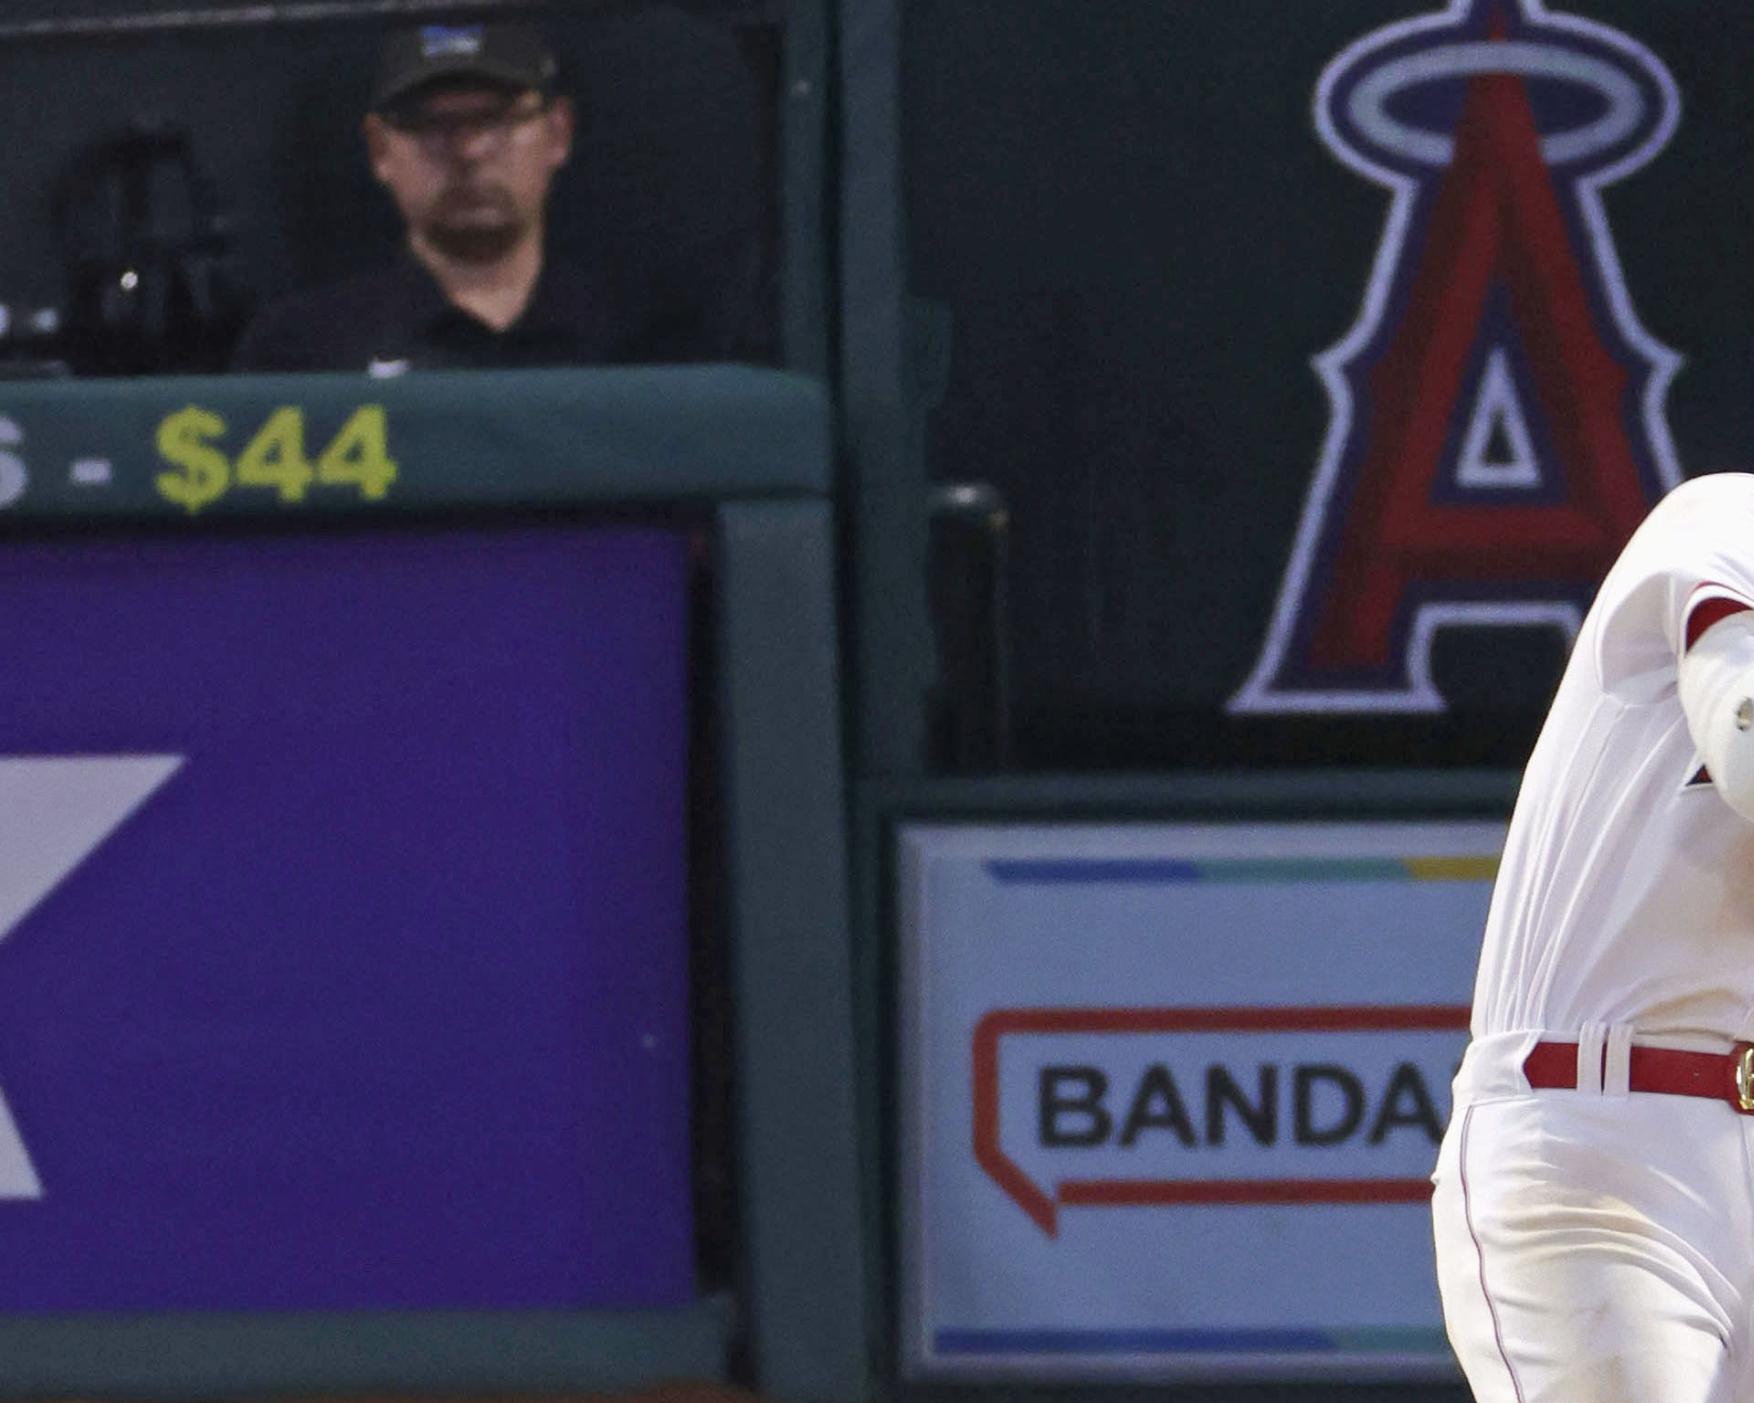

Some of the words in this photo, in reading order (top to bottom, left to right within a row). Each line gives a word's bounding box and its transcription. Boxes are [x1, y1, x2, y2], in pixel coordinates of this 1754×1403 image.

[1227, 0, 1686, 713] A
[154, 403, 398, 516] $44
[1040, 1063, 1456, 1148] BANDA
